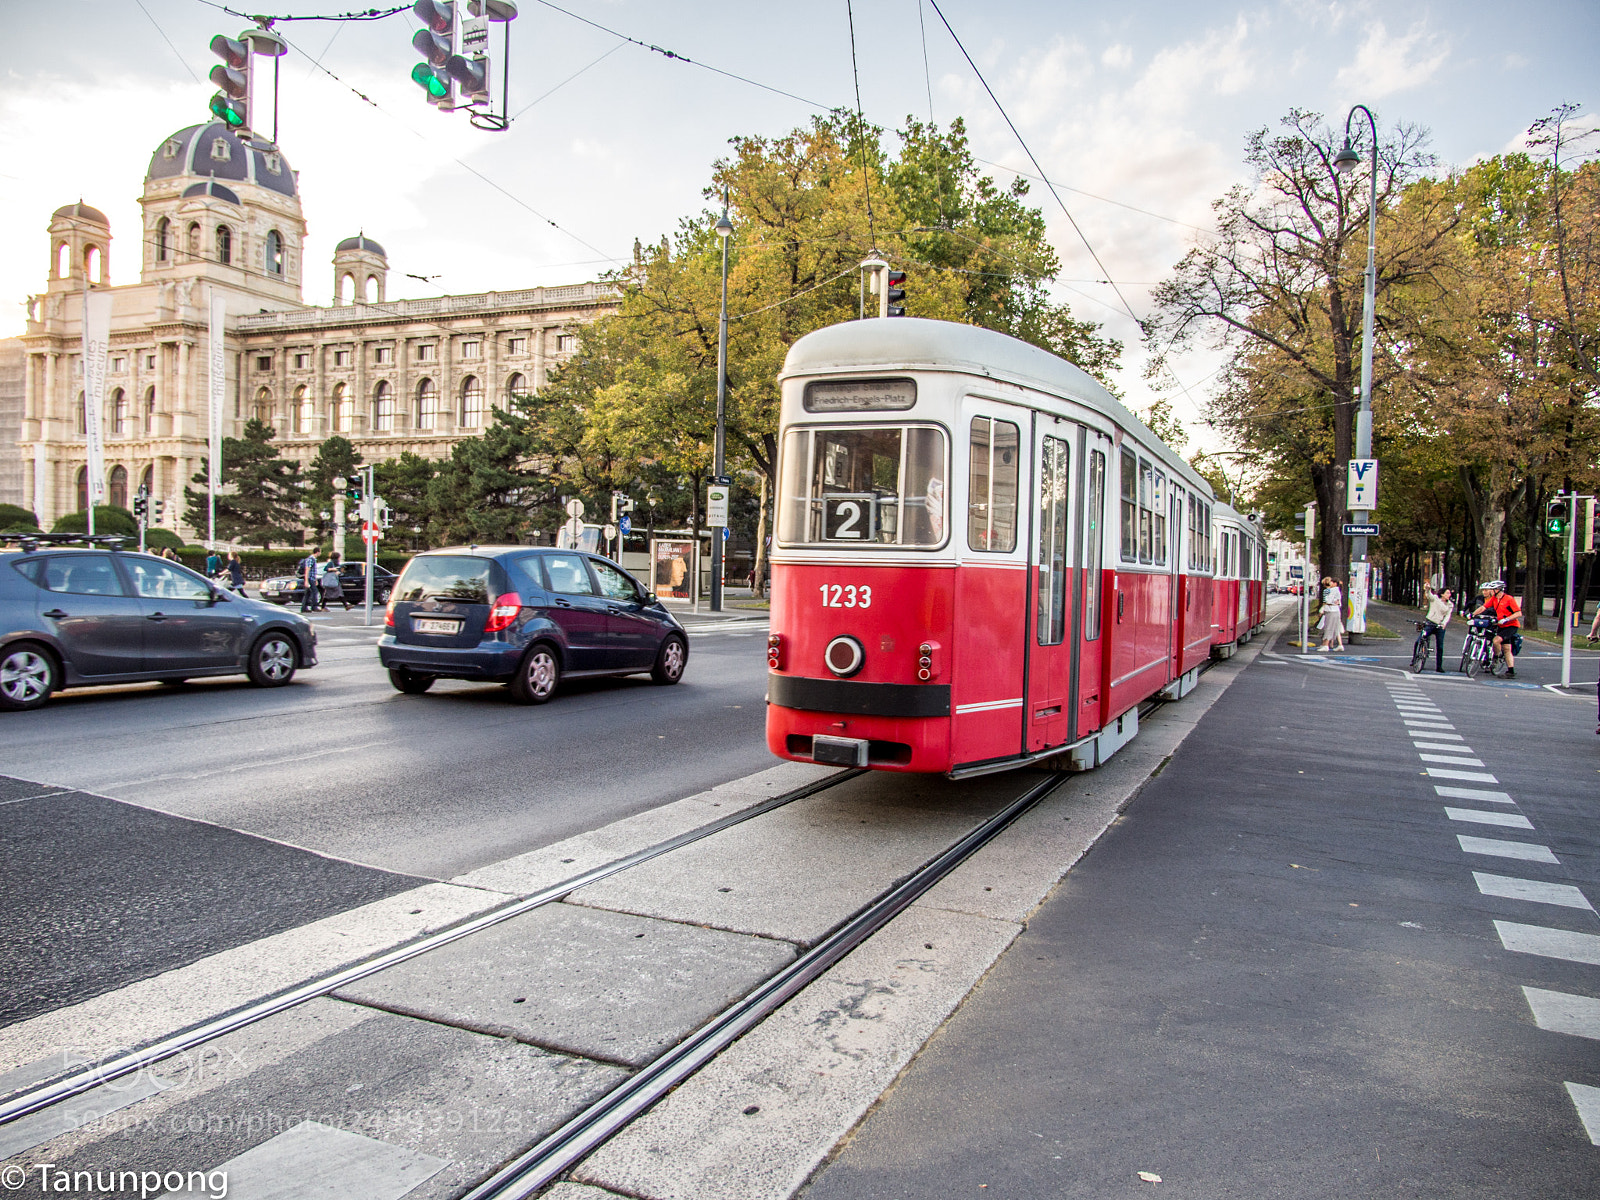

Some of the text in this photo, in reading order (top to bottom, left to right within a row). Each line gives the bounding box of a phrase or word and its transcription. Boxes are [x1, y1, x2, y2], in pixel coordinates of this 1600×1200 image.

[814, 395, 906, 404] Friedrich-Engels-Platz
[835, 501, 861, 538] 2
[819, 584, 872, 609] 1233
